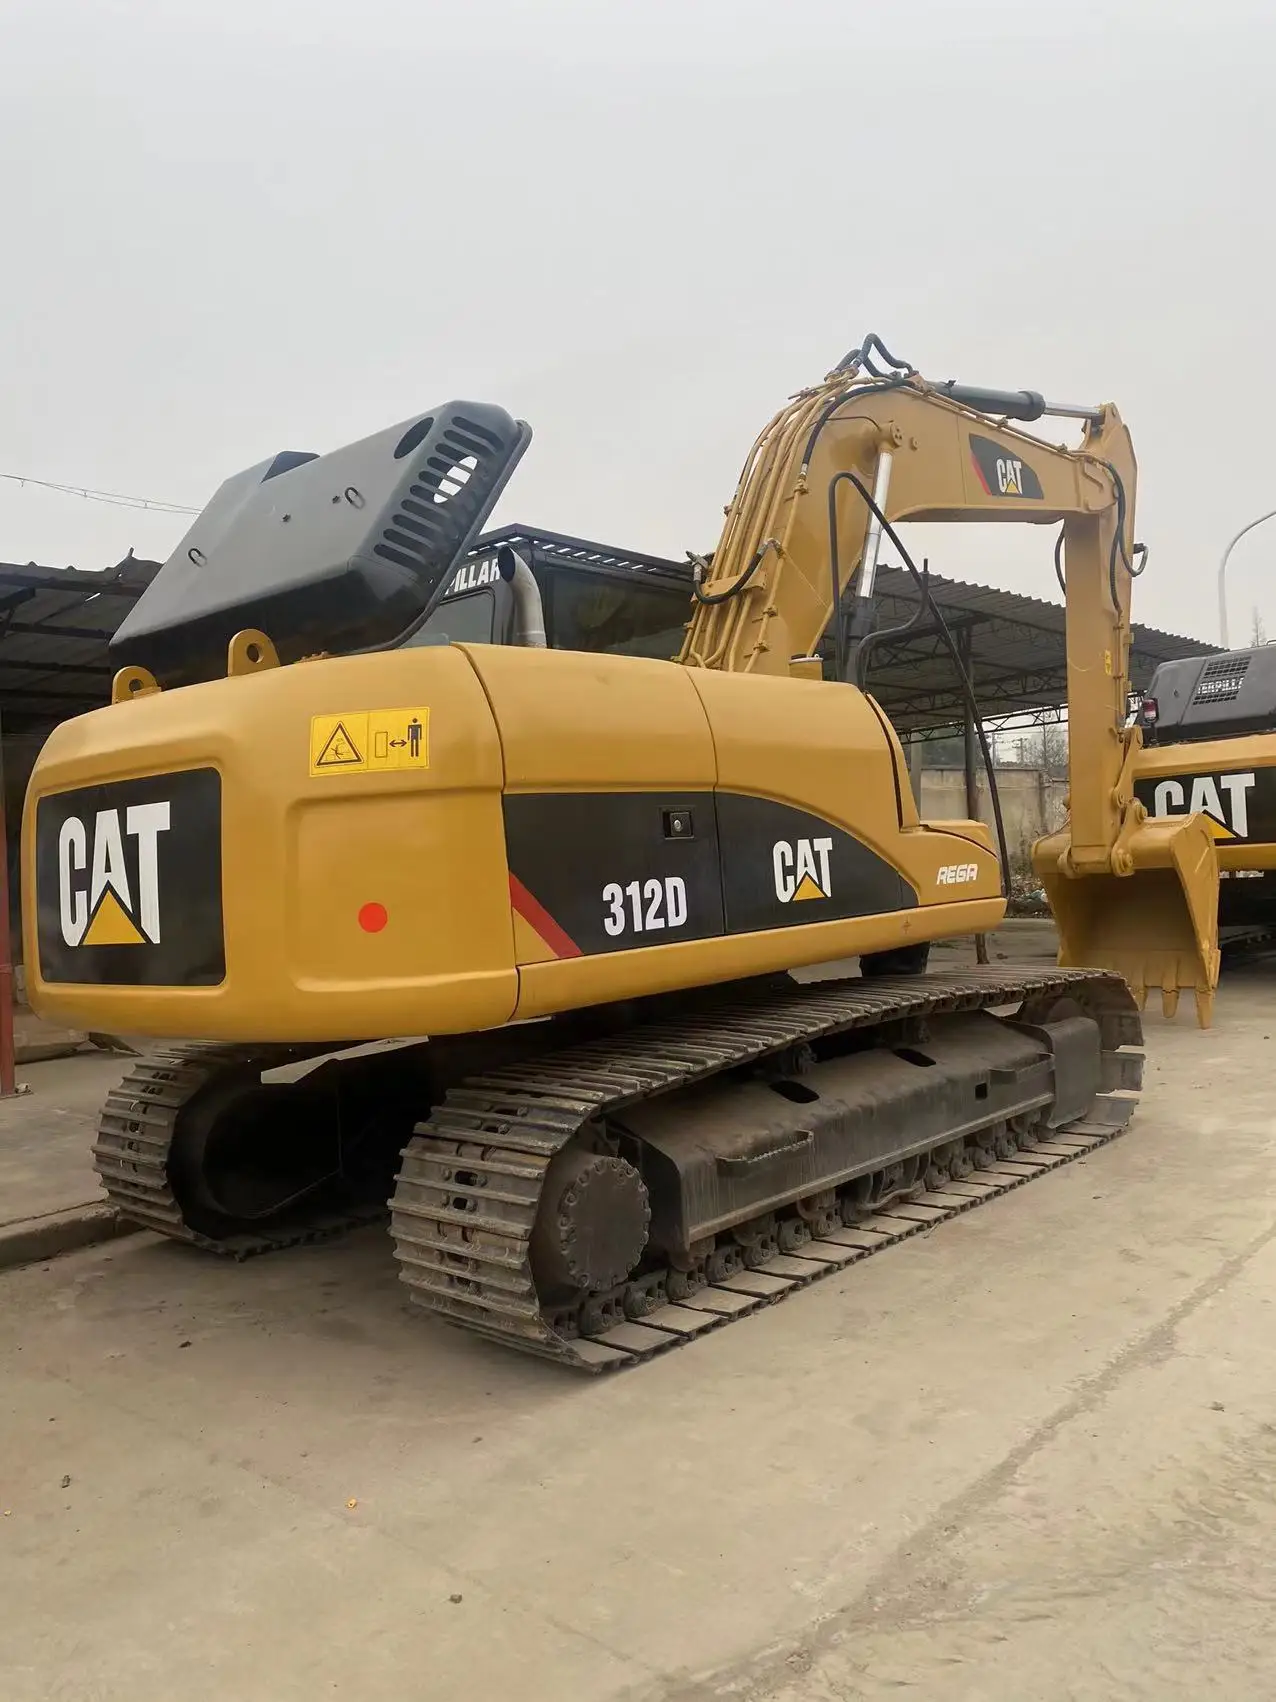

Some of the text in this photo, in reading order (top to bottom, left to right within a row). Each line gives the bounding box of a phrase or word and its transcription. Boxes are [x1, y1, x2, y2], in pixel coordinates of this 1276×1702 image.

[996, 458, 1023, 495] CAT
[58, 801, 171, 947] CAT
[773, 837, 833, 903] CAT
[936, 863, 979, 885] REGA
[602, 877, 688, 936] 312D
